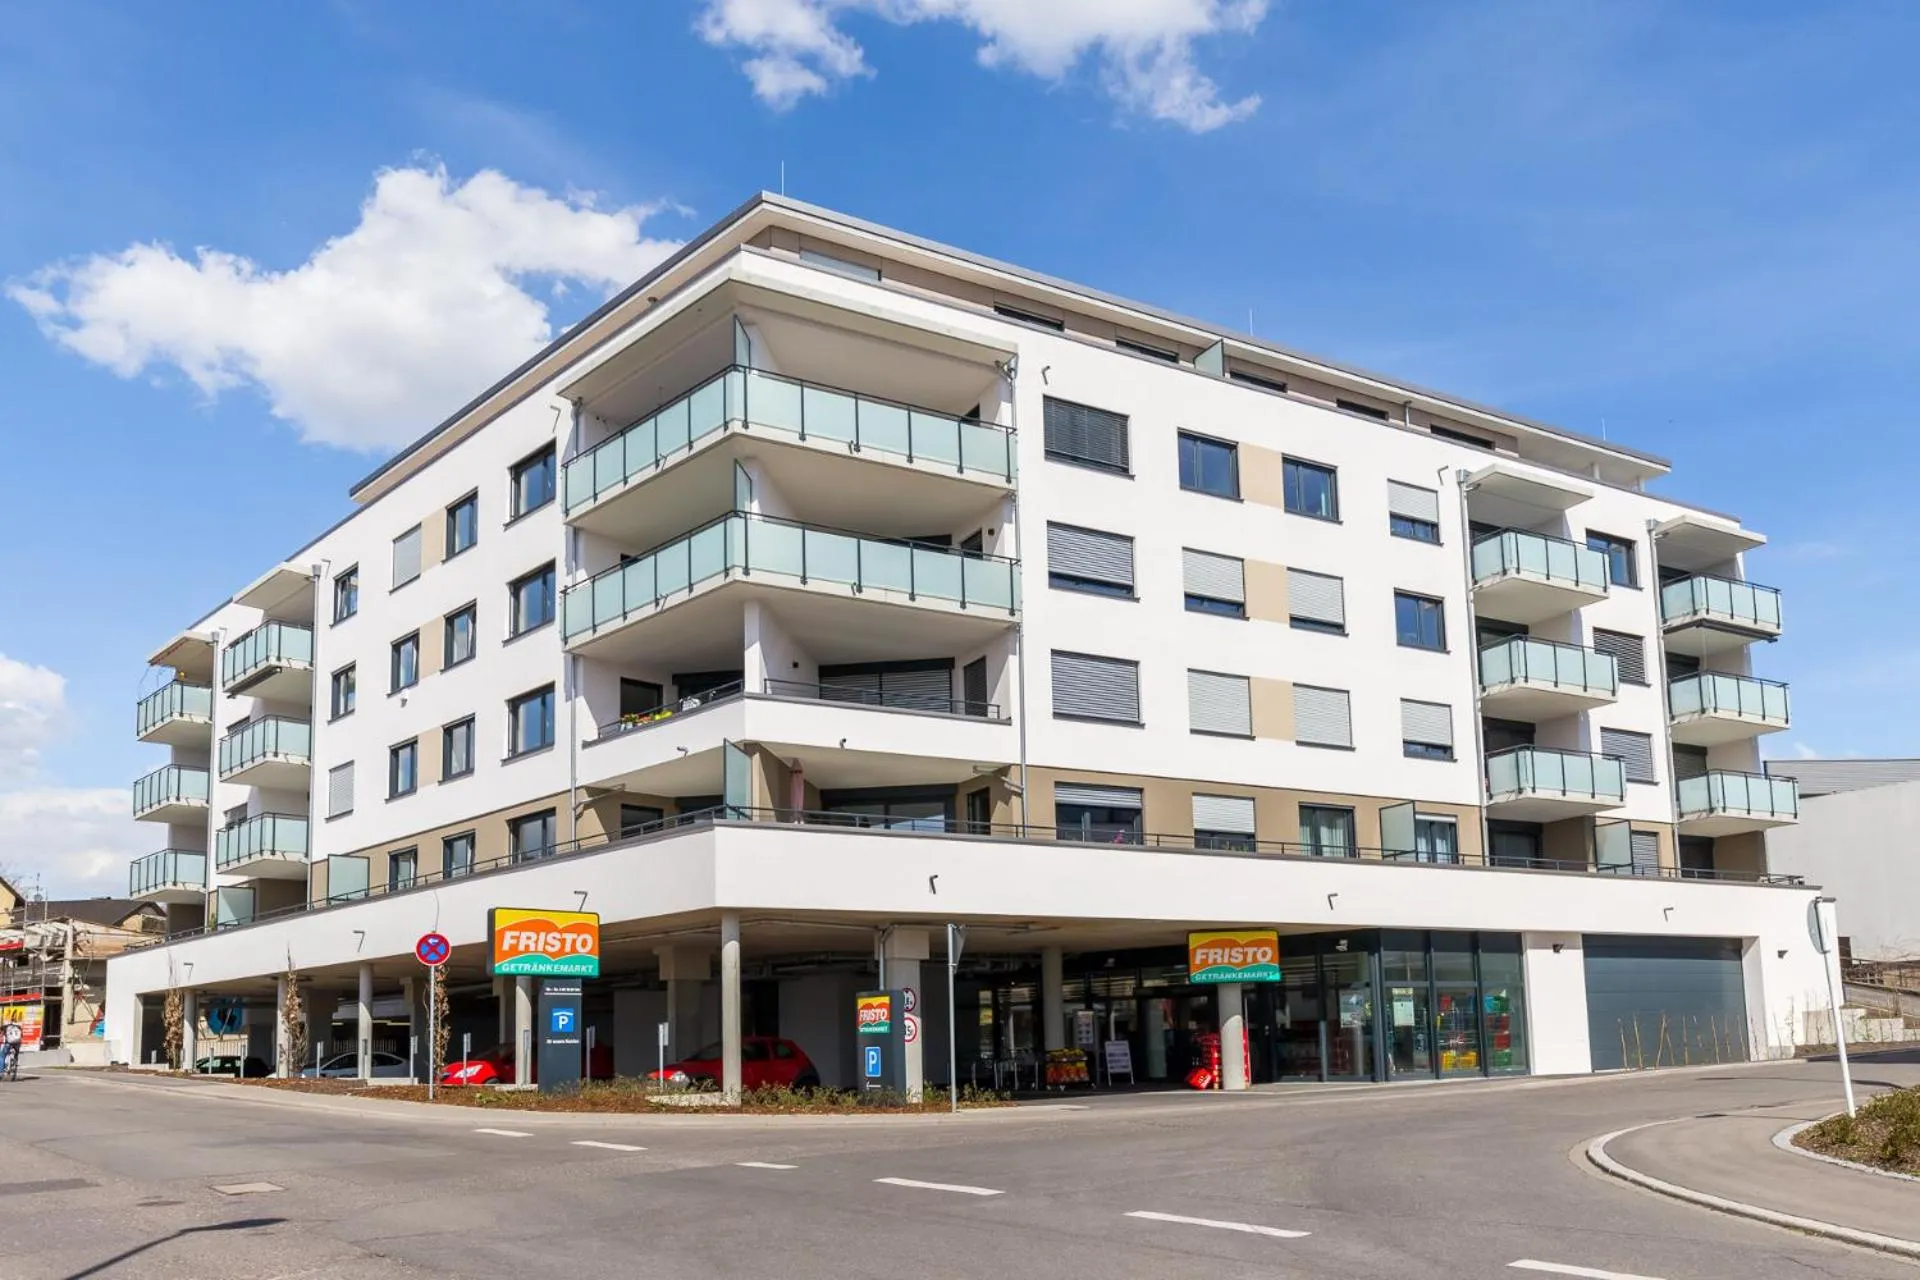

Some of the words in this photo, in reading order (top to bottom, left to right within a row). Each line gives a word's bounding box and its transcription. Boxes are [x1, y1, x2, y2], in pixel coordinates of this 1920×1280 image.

[502, 931, 593, 953] FRISTO
[1195, 946, 1273, 965] FRISTO
[502, 961, 593, 973] GETRÄNKEMARKT
[868, 1050, 878, 1072] P
